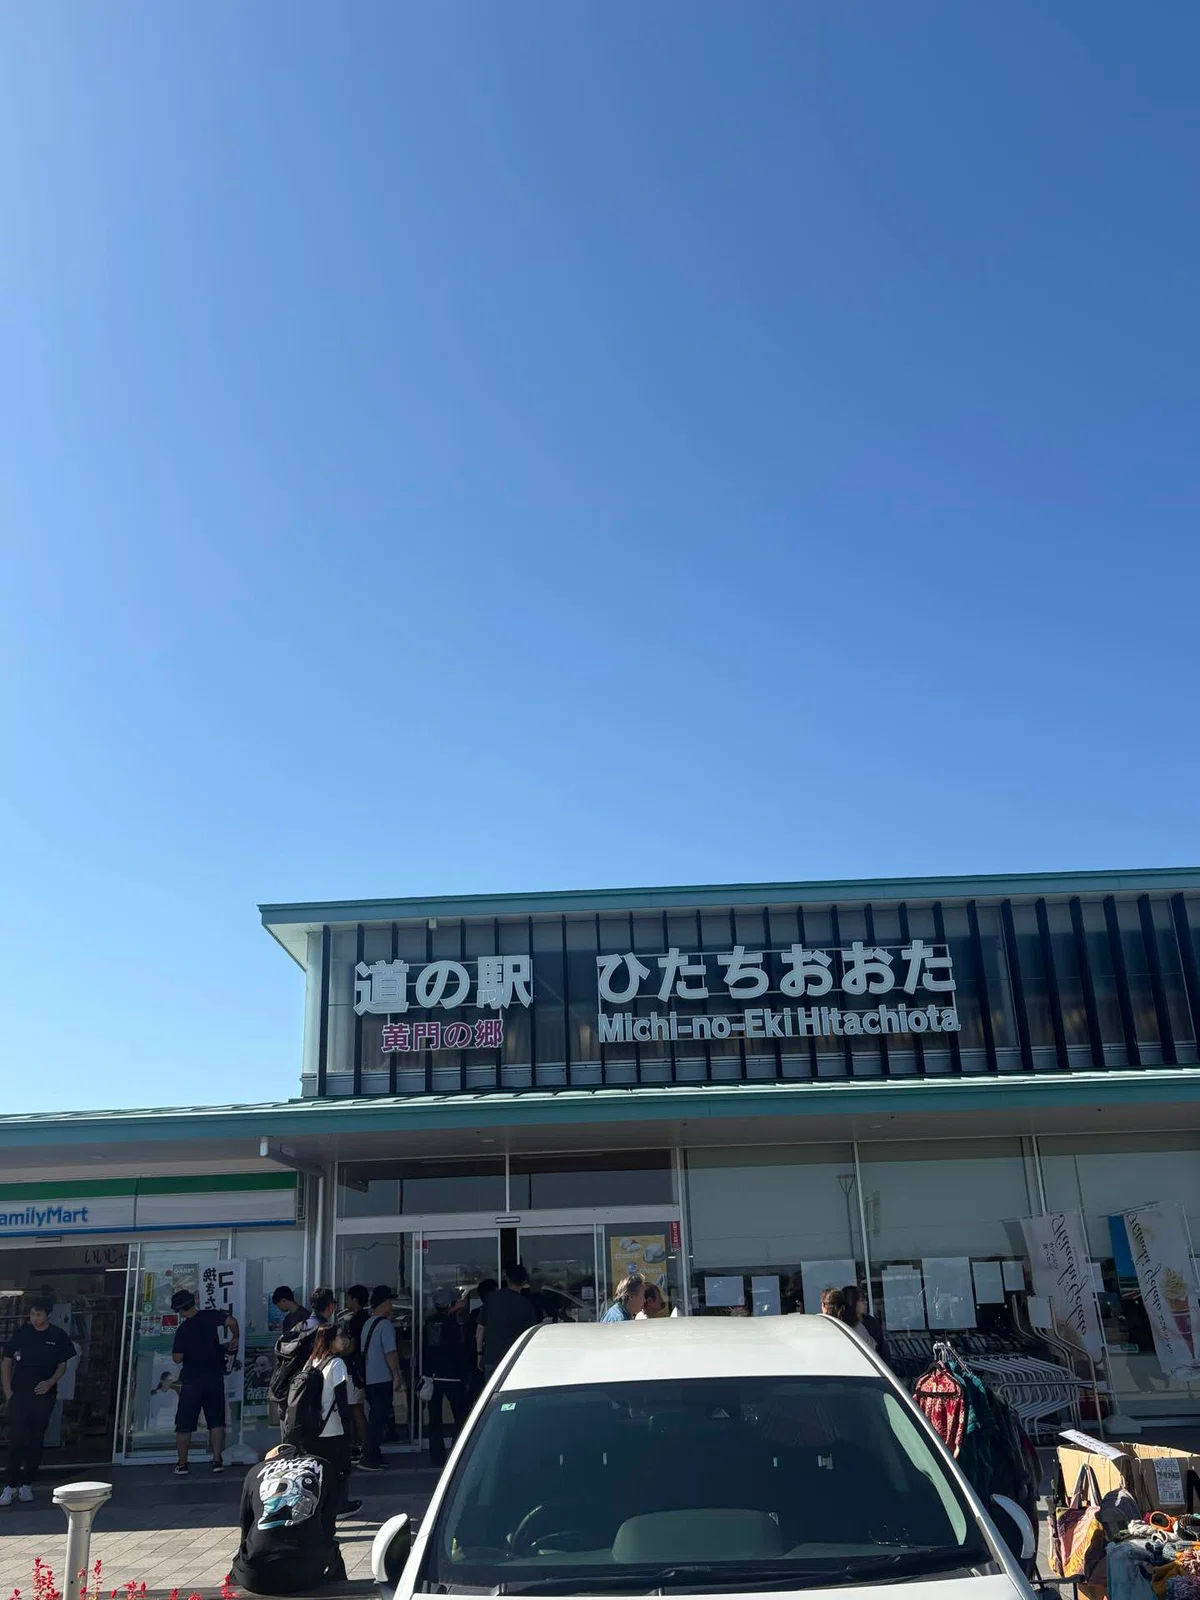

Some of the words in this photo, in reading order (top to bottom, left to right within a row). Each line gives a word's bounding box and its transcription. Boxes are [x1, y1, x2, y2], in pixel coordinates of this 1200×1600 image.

[353, 955, 532, 1016] 道の駅
[596, 939, 957, 1003] ひたちおおた
[381, 1019, 504, 1053] 黄門の郷
[598, 1007, 792, 1043] Michi-no-Eki
[797, 1003, 961, 1036] Hitachiota
